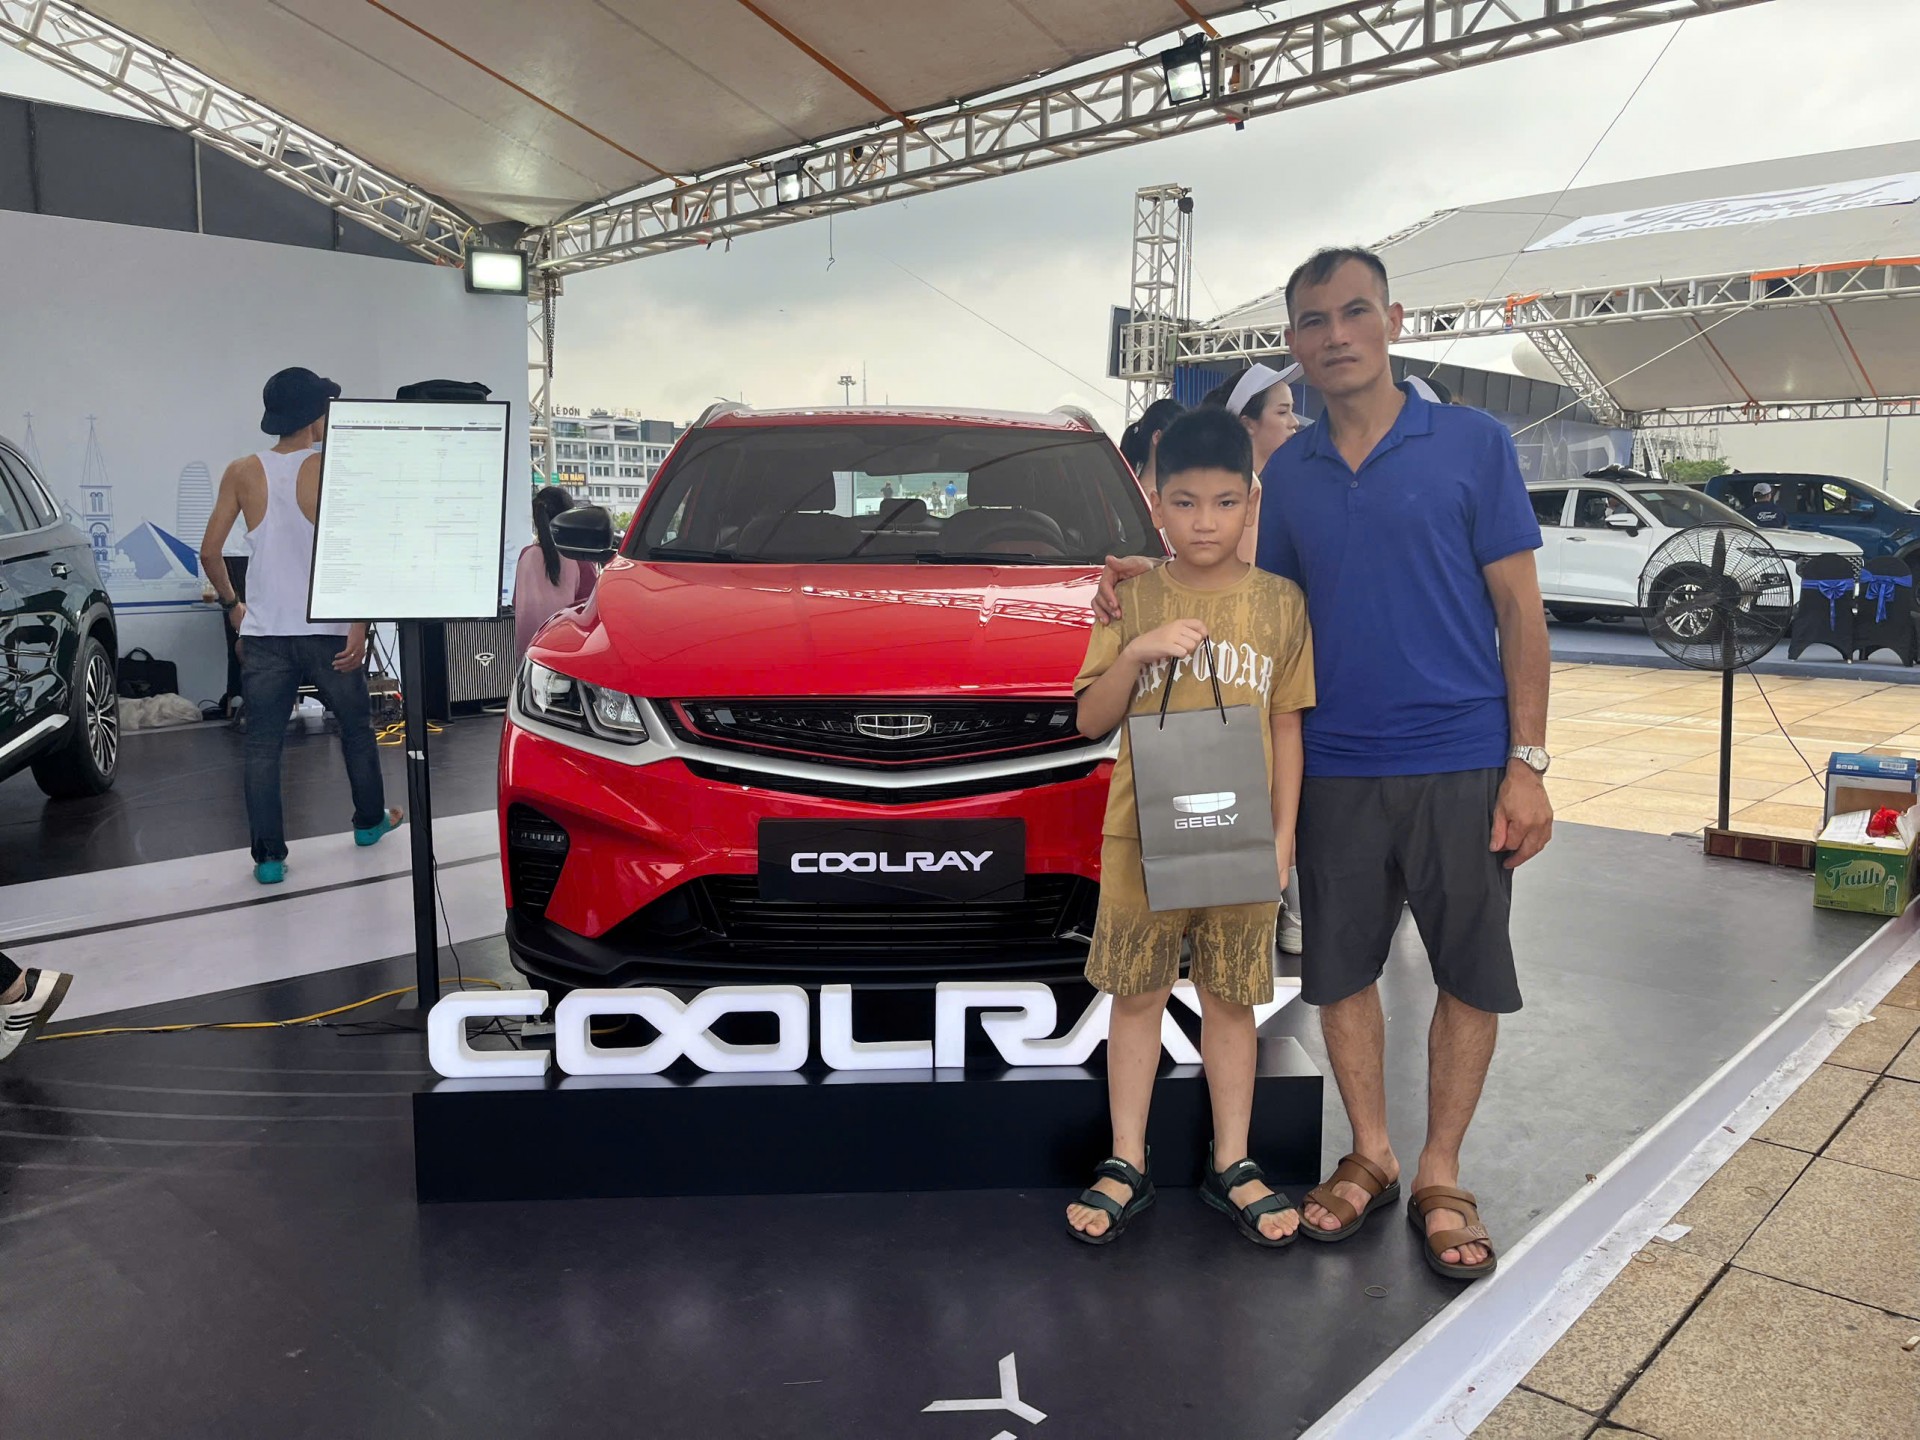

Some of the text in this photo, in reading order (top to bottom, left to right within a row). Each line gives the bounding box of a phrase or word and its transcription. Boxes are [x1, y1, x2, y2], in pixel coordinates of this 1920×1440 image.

[1576, 180, 1905, 238] Ford
[1756, 511, 1777, 520] Ford
[1174, 813, 1239, 830] GEELY
[790, 850, 994, 873] COOLRAY
[1825, 860, 1881, 893] Faith
